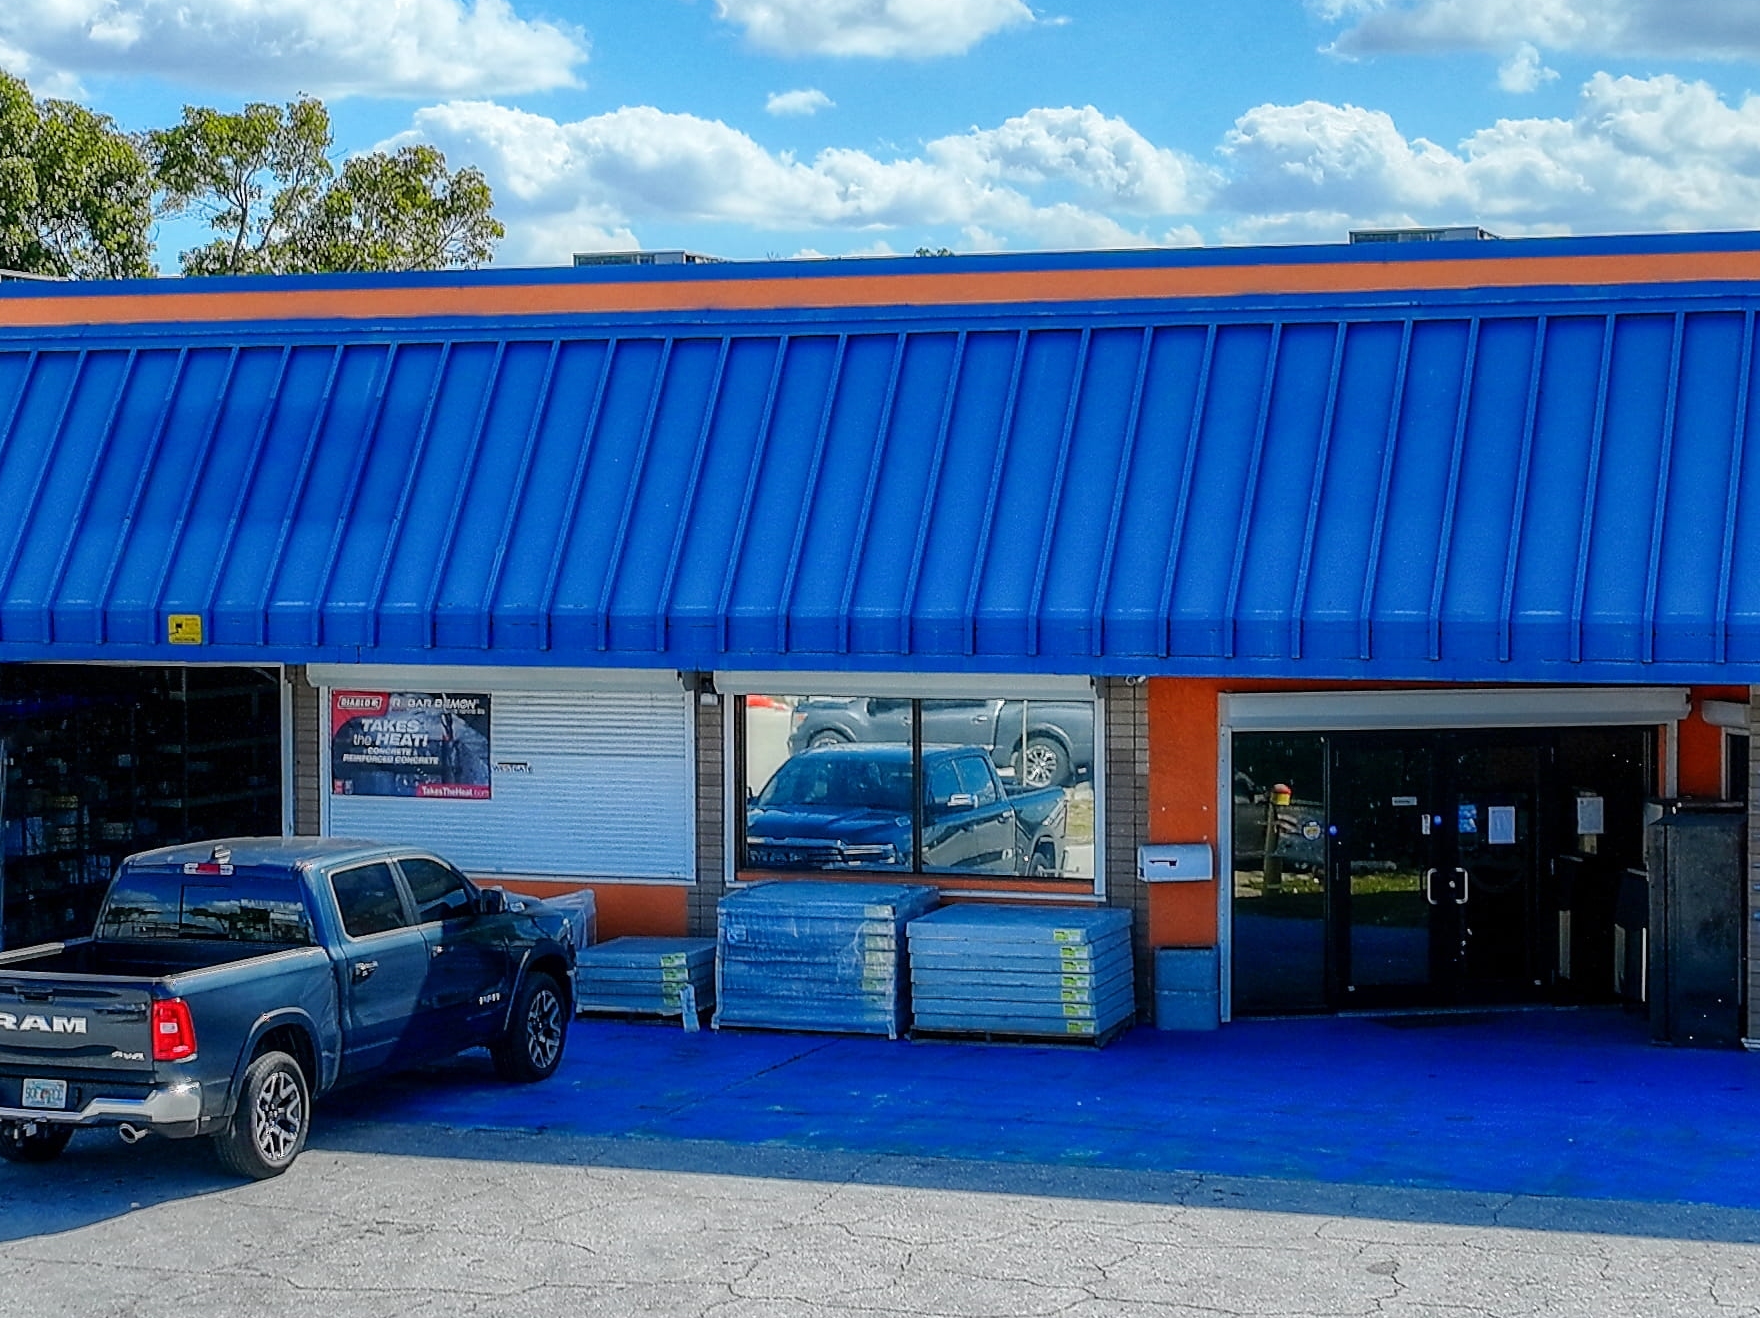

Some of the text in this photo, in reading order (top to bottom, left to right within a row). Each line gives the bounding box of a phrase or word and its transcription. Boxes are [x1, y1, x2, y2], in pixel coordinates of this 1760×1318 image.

[361, 718, 421, 732] TAKES
[353, 733, 429, 747] the HEAT!
[367, 747, 412, 756] CONCRETE
[342, 753, 440, 765] REINFORCED CONCRETE
